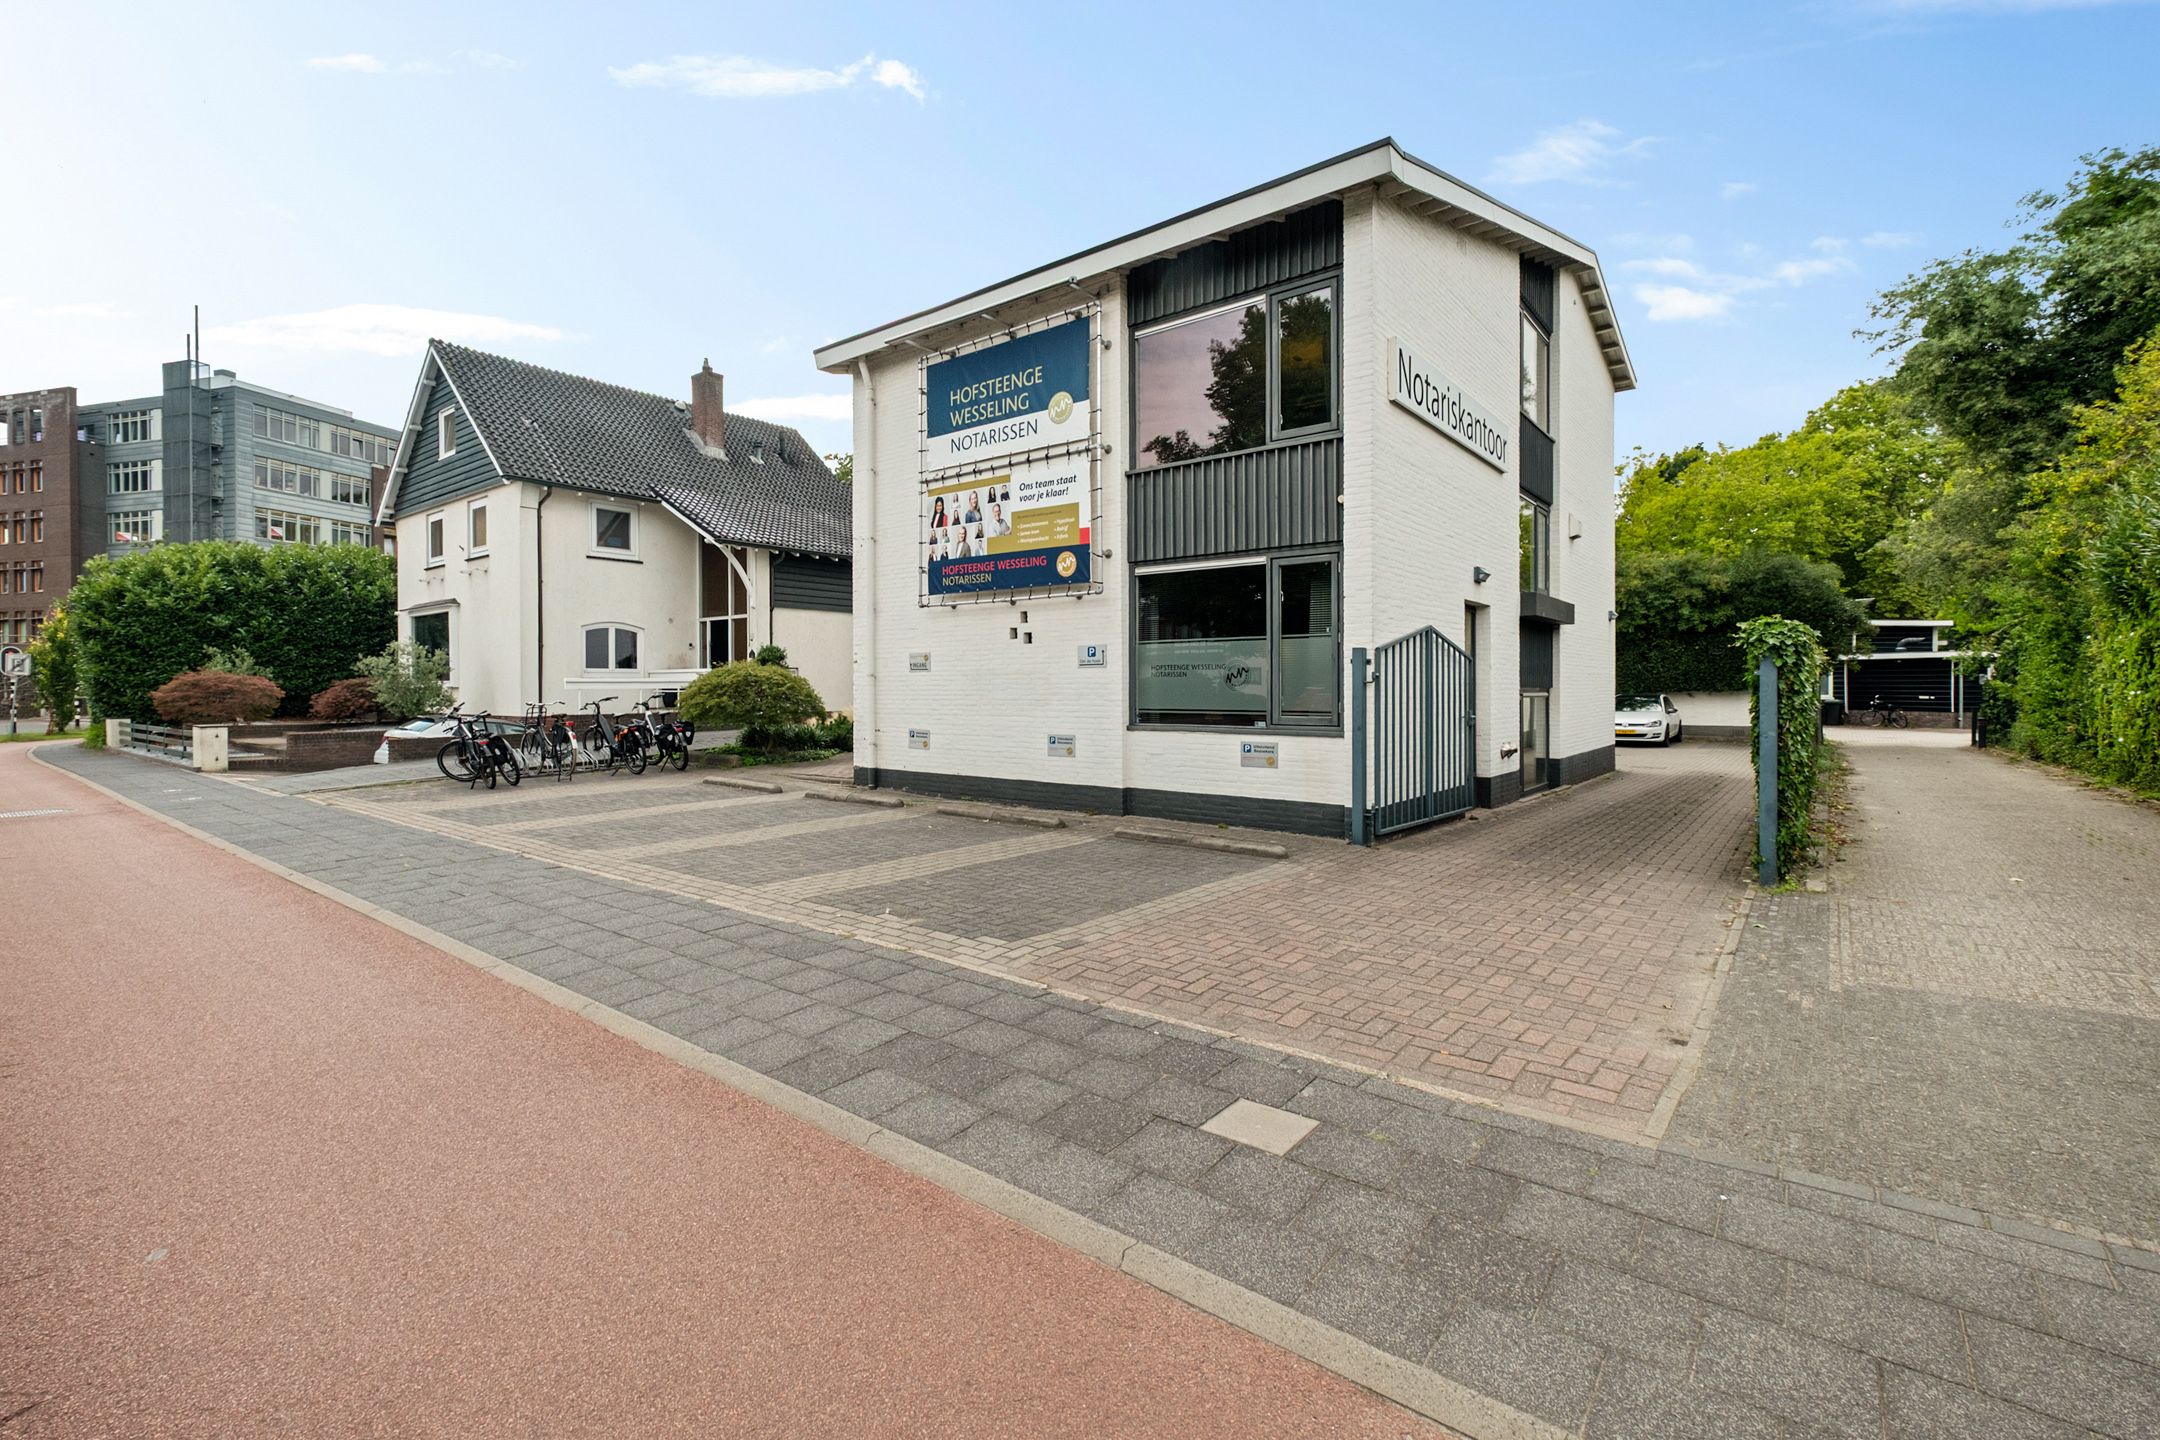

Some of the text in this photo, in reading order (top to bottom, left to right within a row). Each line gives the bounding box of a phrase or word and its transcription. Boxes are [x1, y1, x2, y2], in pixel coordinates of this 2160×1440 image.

[950, 366, 1043, 406] HOFSTEENGE
[950, 393, 1029, 427] WESSELING
[1399, 347, 1507, 463] Notariskantoor
[951, 419, 1038, 453] NOTARISSEN
[1019, 474, 1077, 492] Ons team staat
[1019, 486, 1069, 502] voor je klaar!
[942, 555, 1047, 575] HOFSTEENGE WESSELING
[942, 573, 992, 586] NOTARISSEN
